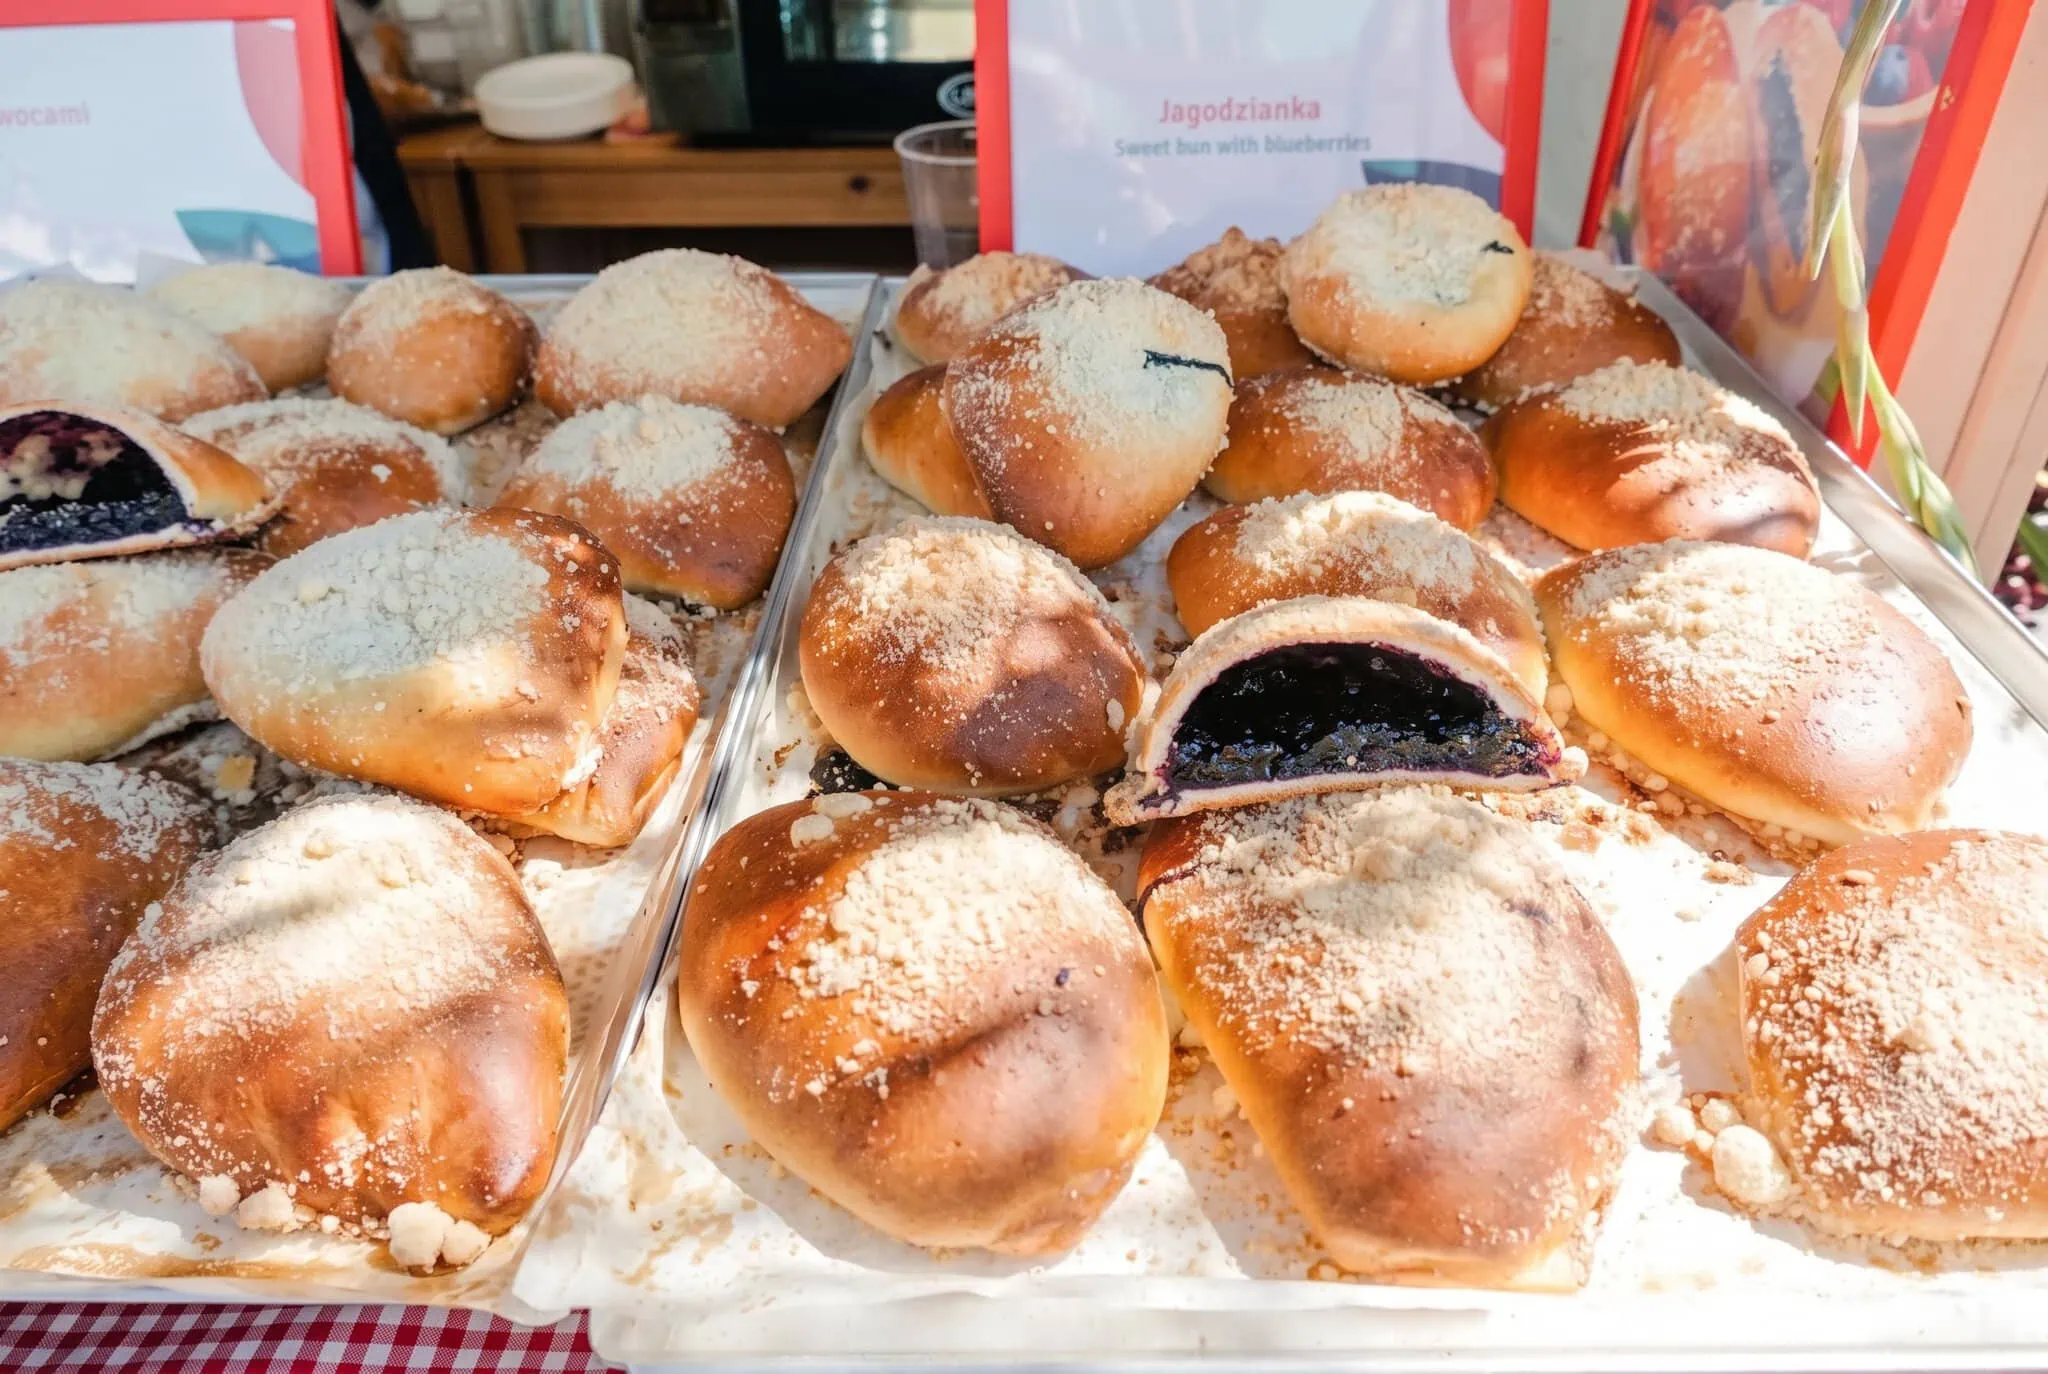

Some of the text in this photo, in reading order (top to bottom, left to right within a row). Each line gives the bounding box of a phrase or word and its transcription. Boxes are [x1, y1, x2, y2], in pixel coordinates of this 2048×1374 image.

[1159, 96, 1322, 129] Jagodzianka
[1114, 132, 1372, 157] Sweet bun with blueberries
